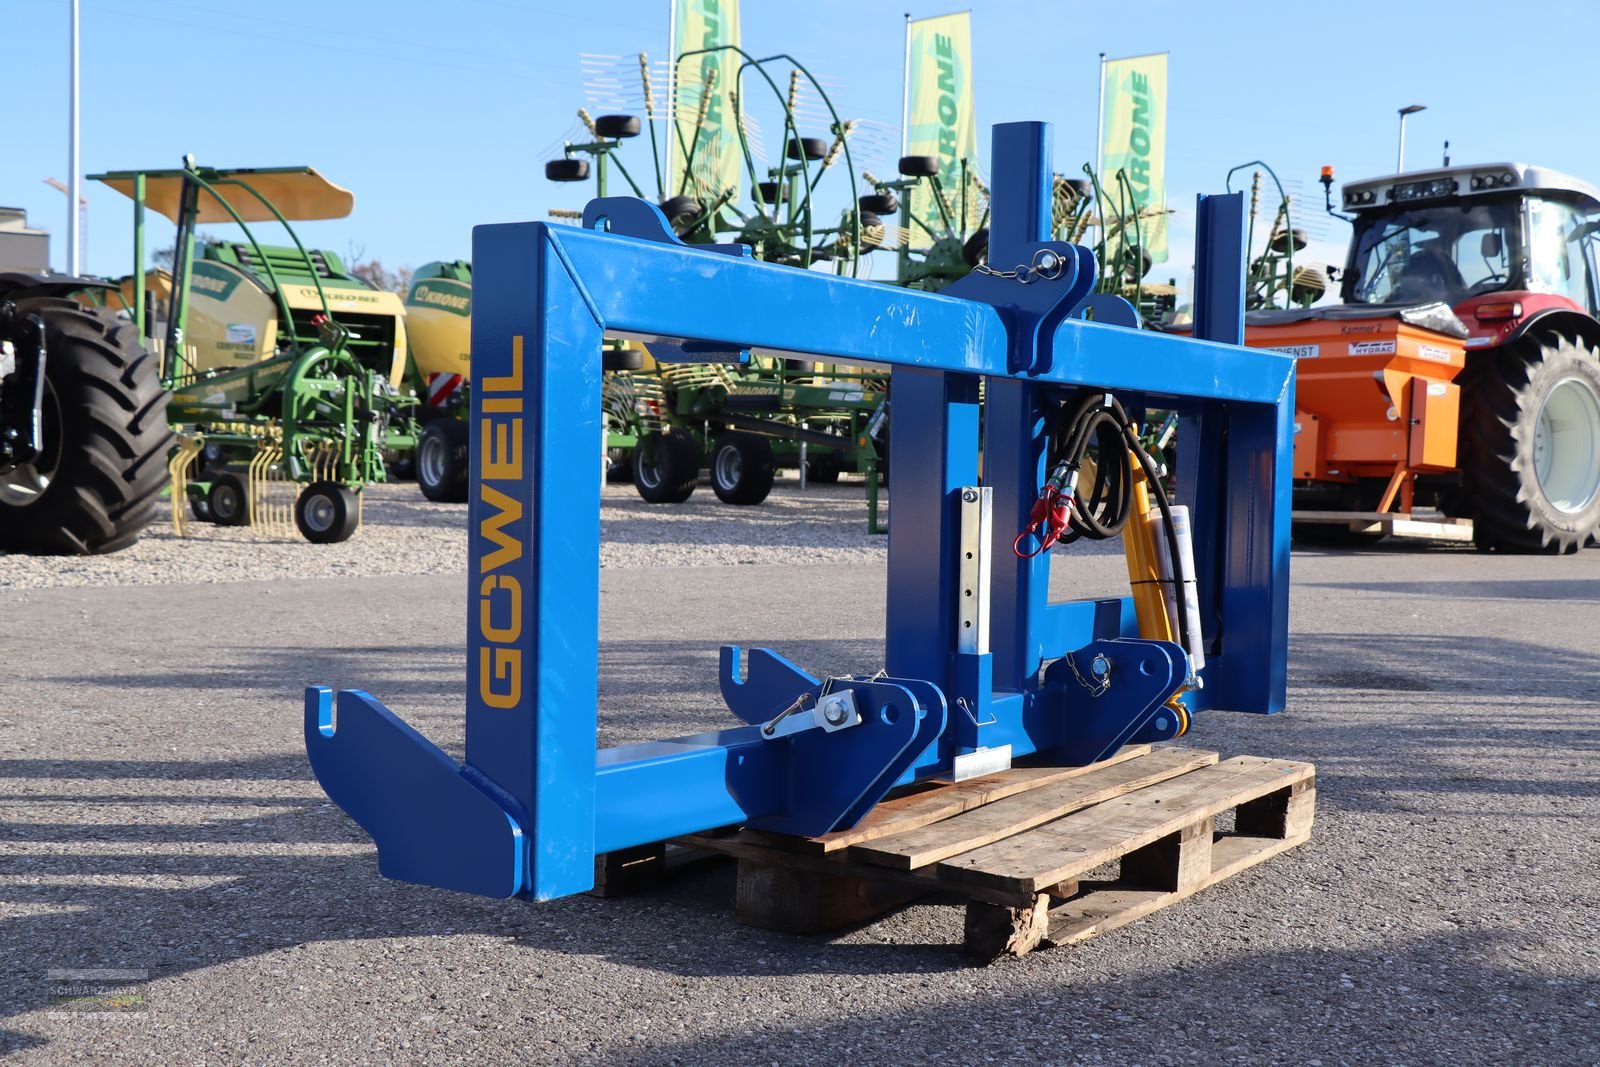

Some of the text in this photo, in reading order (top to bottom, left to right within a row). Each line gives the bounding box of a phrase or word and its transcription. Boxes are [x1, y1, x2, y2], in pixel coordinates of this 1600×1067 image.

[935, 32, 957, 190] KRONE
[425, 290, 469, 310] KRONE
[1341, 323, 1382, 335] Kammer 2
[1355, 345, 1393, 354] HYDRAC
